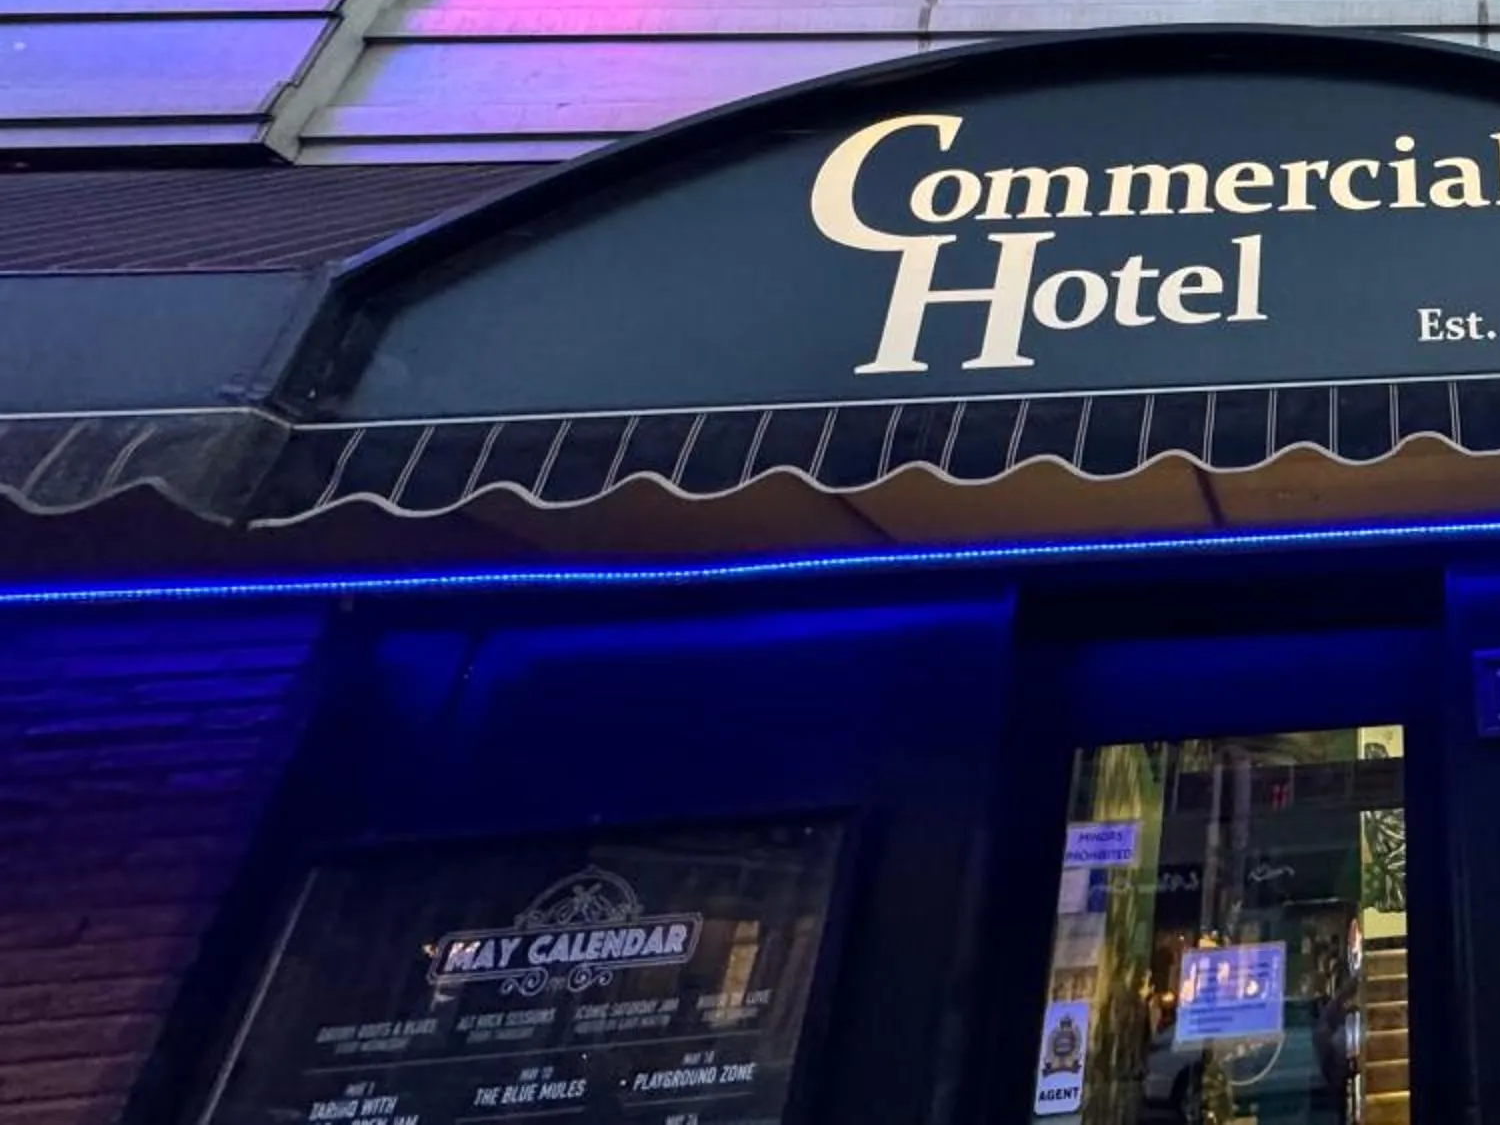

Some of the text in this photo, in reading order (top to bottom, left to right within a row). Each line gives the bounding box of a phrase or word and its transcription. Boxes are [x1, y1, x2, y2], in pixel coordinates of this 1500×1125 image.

[854, 231, 1267, 375] Hotel
[1417, 308, 1496, 343] Est.
[1078, 830, 1122, 843] MINORS
[444, 923, 688, 972] MAY CALENDAR
[633, 1061, 758, 1091] PLAYGROUND ZONE
[361, 1095, 399, 1116] WITH
[473, 1086, 501, 1107] THE
[500, 1083, 538, 1105] BLUE
[1038, 1087, 1080, 1102] AGENT
